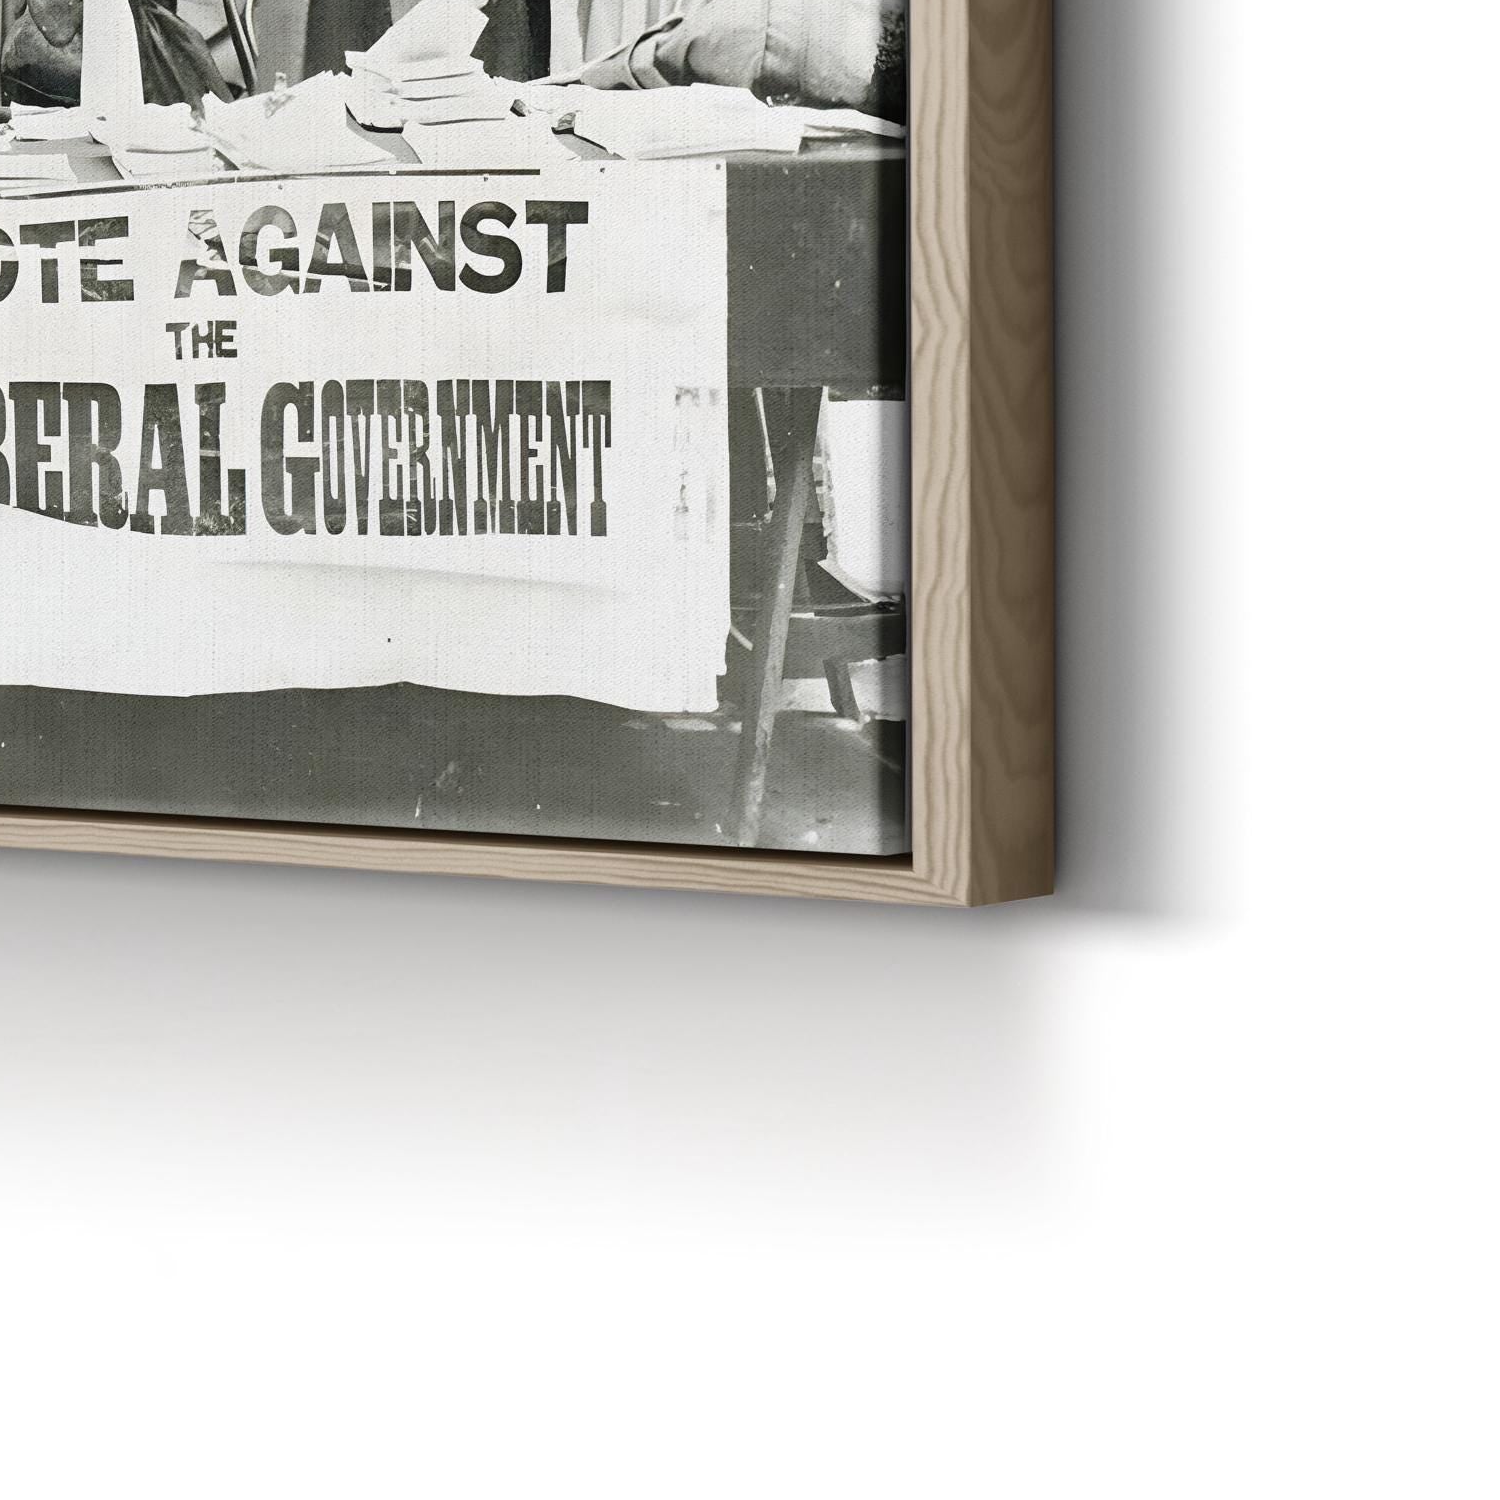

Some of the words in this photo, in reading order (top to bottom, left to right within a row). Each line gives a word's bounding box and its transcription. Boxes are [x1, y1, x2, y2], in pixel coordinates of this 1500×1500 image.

[173, 199, 591, 301] AGAINST
[165, 319, 239, 361] THE
[258, 377, 613, 538] GOVERNMENT
